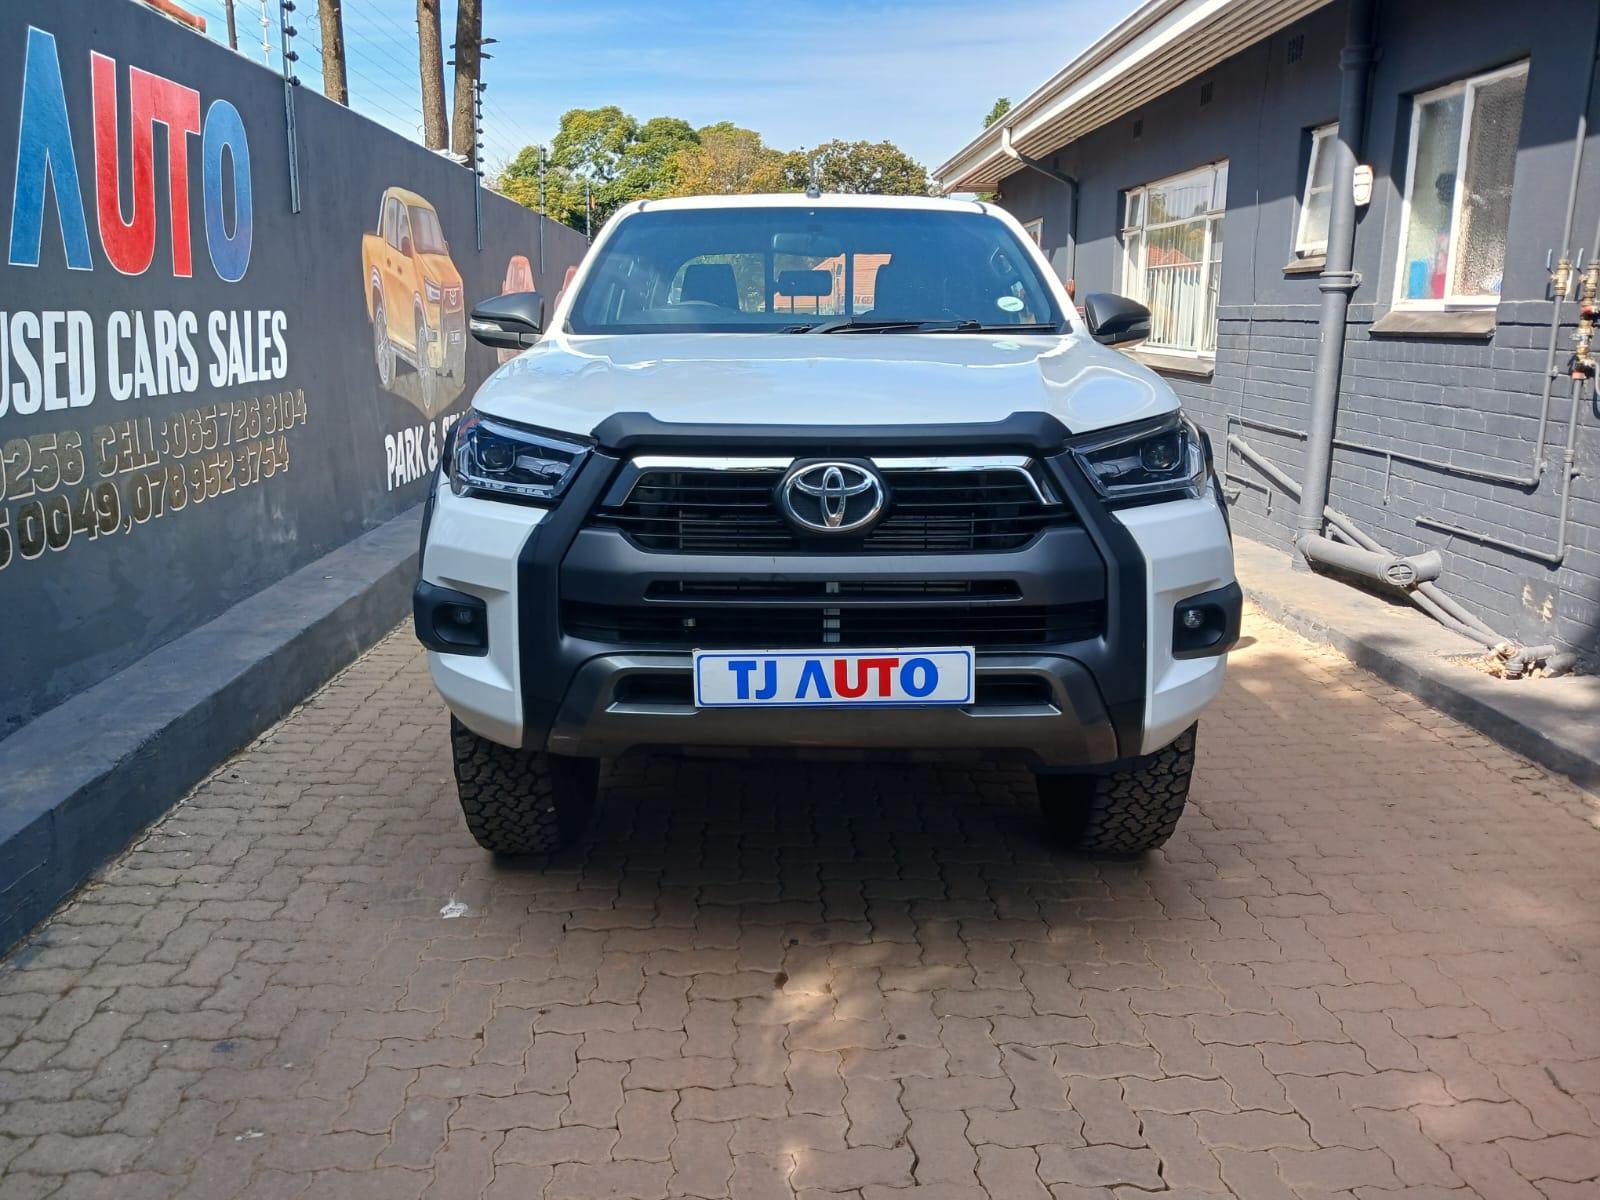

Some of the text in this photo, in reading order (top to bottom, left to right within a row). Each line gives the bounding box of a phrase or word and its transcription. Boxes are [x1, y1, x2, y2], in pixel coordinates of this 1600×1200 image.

[8, 25, 253, 282] AUTO
[107, 310, 200, 401] CARS
[208, 310, 288, 388] SALES
[0, 430, 85, 500] 256
[384, 424, 427, 492] PARK
[427, 421, 439, 472] &
[728, 657, 939, 700] TJ AUTO
